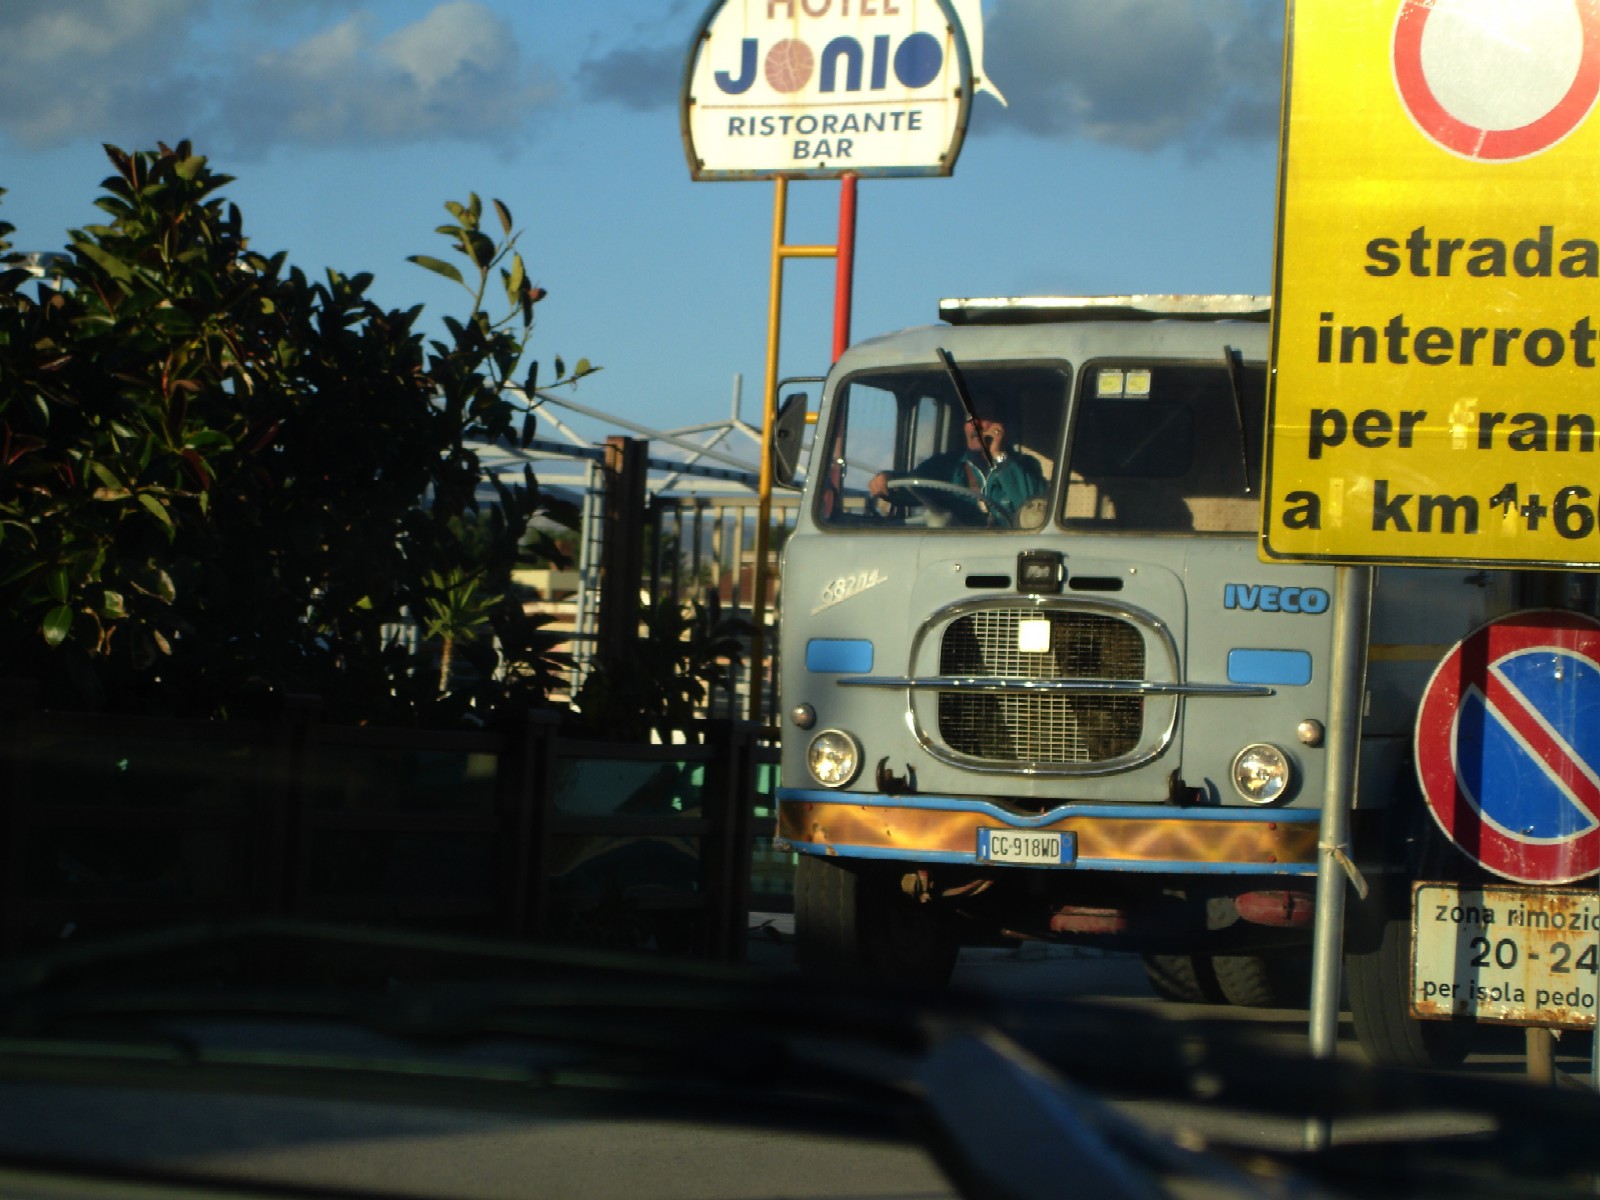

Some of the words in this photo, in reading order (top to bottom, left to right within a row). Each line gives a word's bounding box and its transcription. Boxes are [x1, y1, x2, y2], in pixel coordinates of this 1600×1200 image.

[728, 110, 922, 137] RISTORANTE
[793, 138, 854, 160] BAR
[1364, 225, 1600, 278] strada
[1317, 311, 1600, 368] interrot
[1308, 407, 1427, 460] per
[1449, 397, 1600, 453] fran
[1371, 479, 1480, 534] km
[1489, 481, 1600, 540] 1+6
[1224, 583, 1330, 614] IVECO
[1435, 905, 1495, 924] zona
[1423, 980, 1460, 1001] per
[1469, 980, 1526, 1004] isola
[1536, 987, 1596, 1009] pedo
